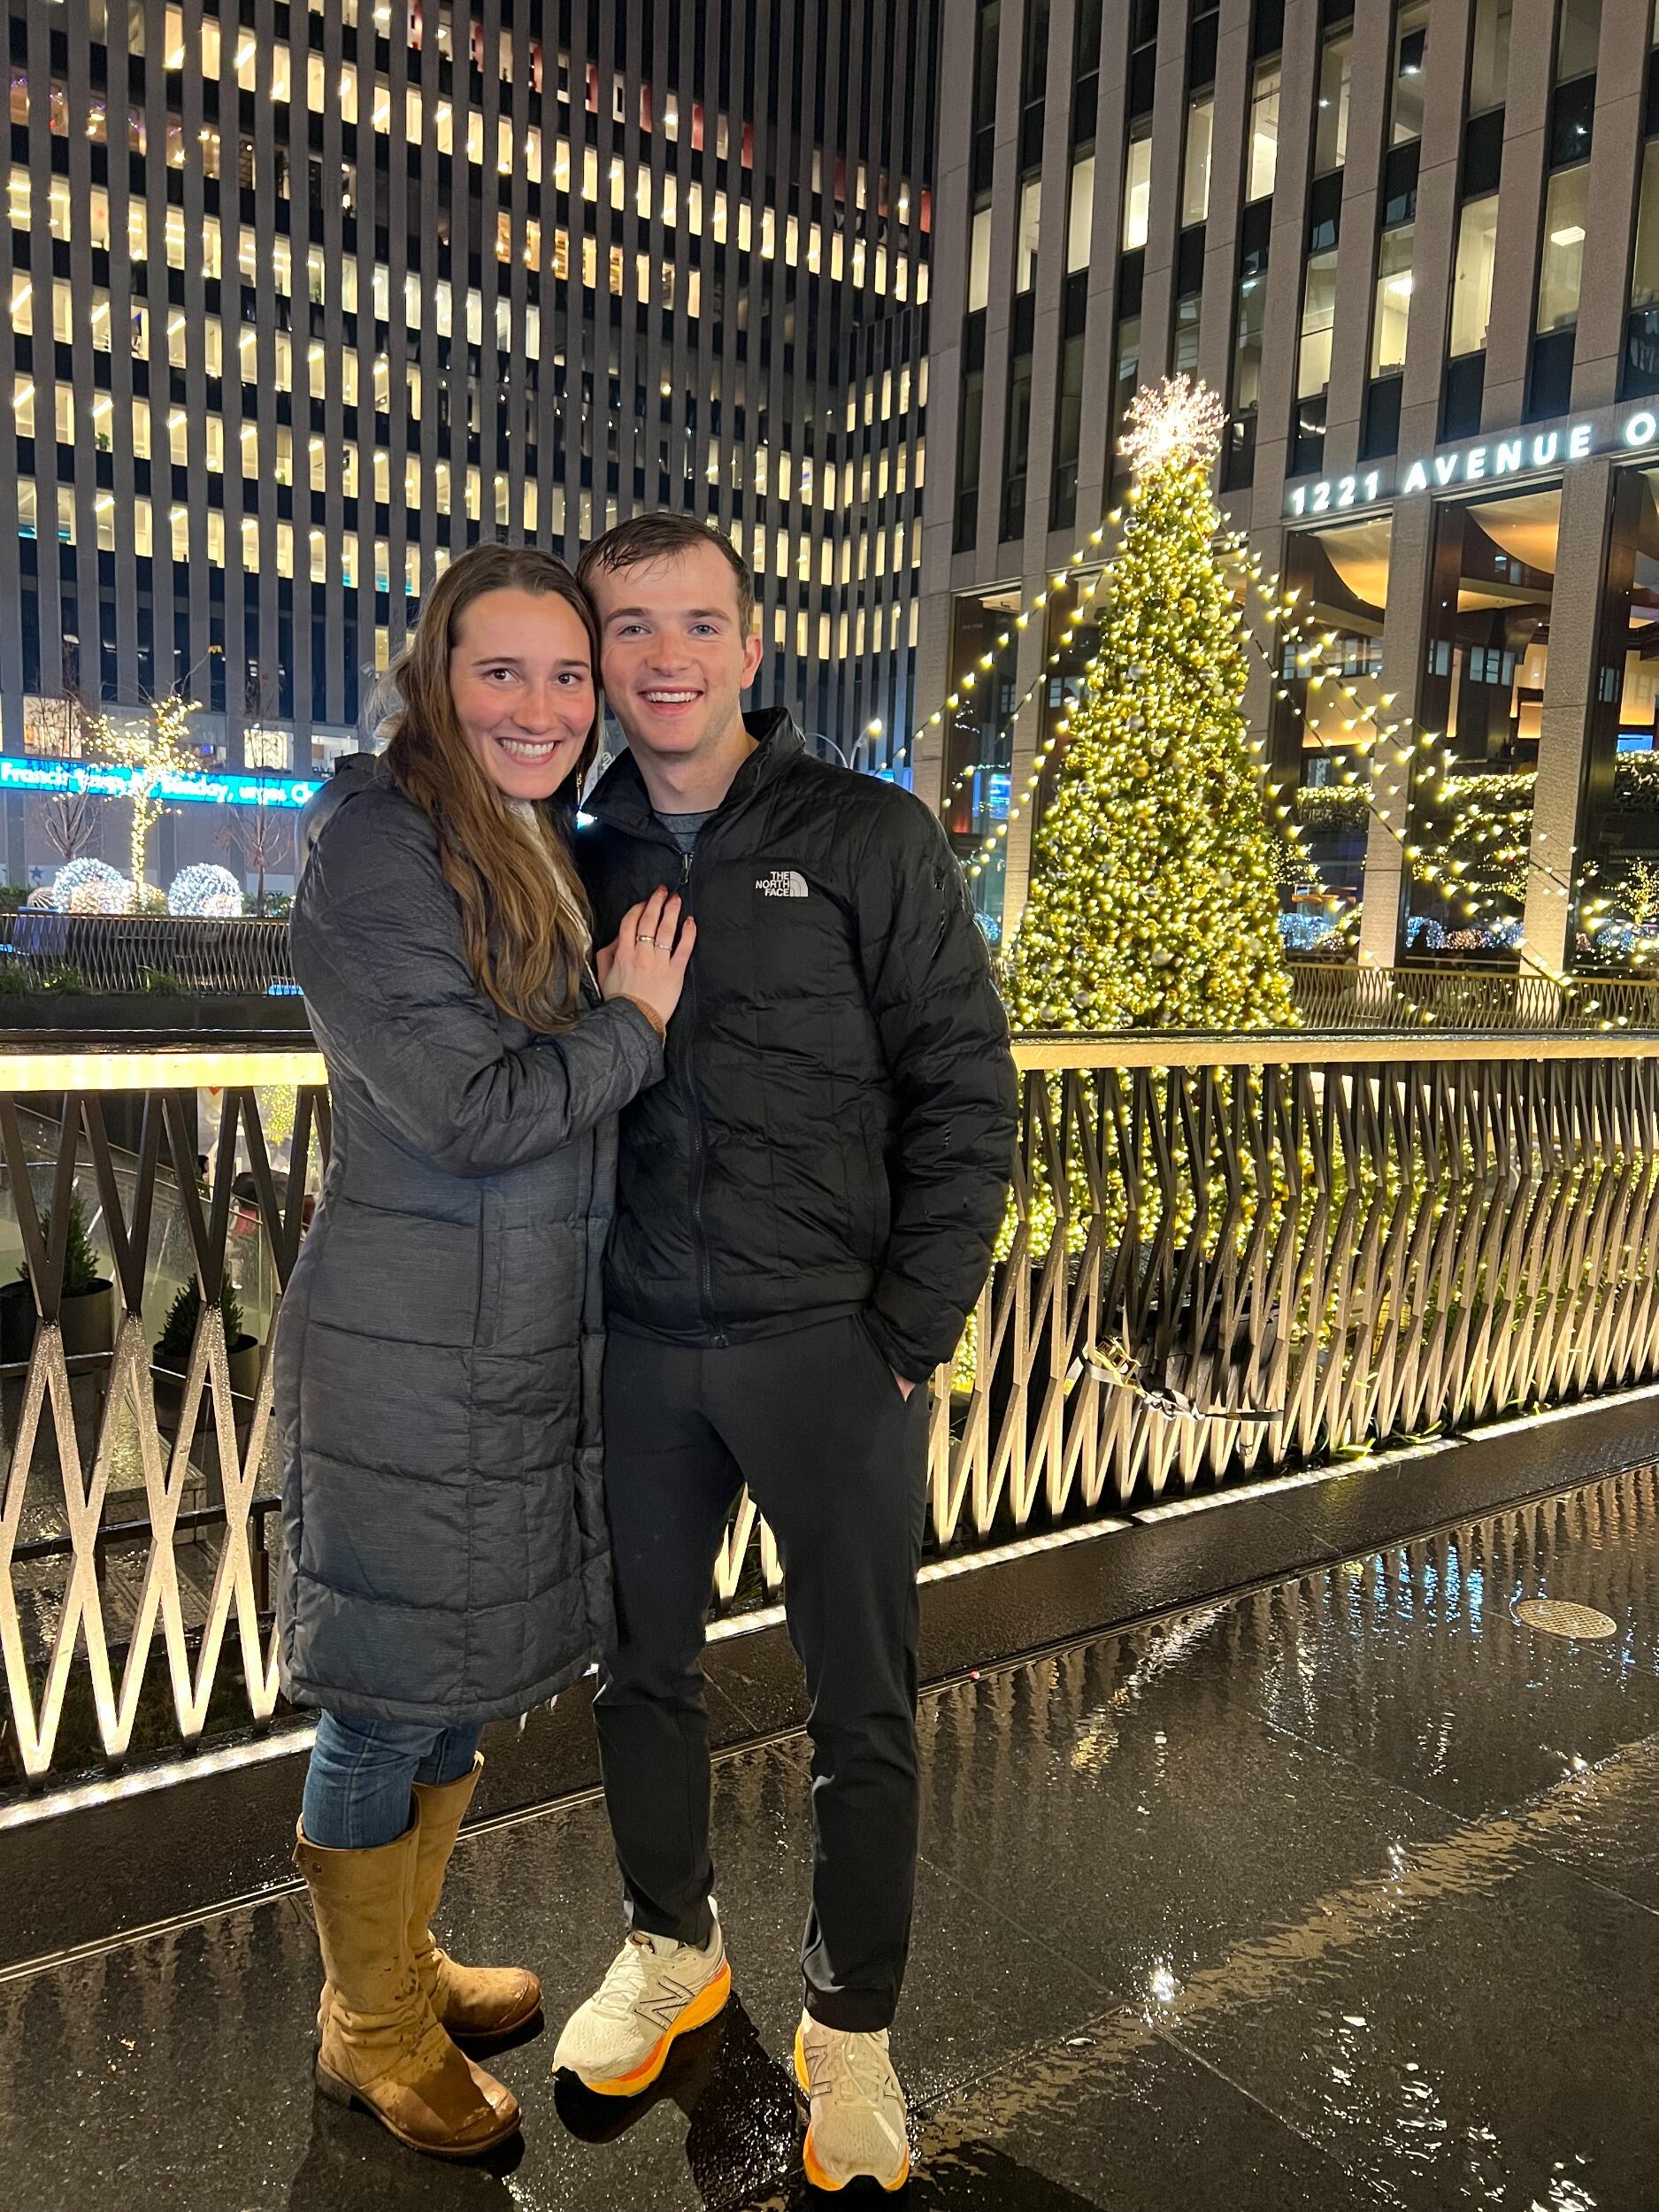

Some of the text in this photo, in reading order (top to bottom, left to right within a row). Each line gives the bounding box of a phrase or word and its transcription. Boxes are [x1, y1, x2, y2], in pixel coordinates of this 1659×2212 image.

[1292, 471, 1379, 516] 1221
[1403, 424, 1593, 495] AVENUE
[770, 871, 790, 880] THE
[755, 879, 790, 889] NORTH
[764, 888, 790, 897] FACE
